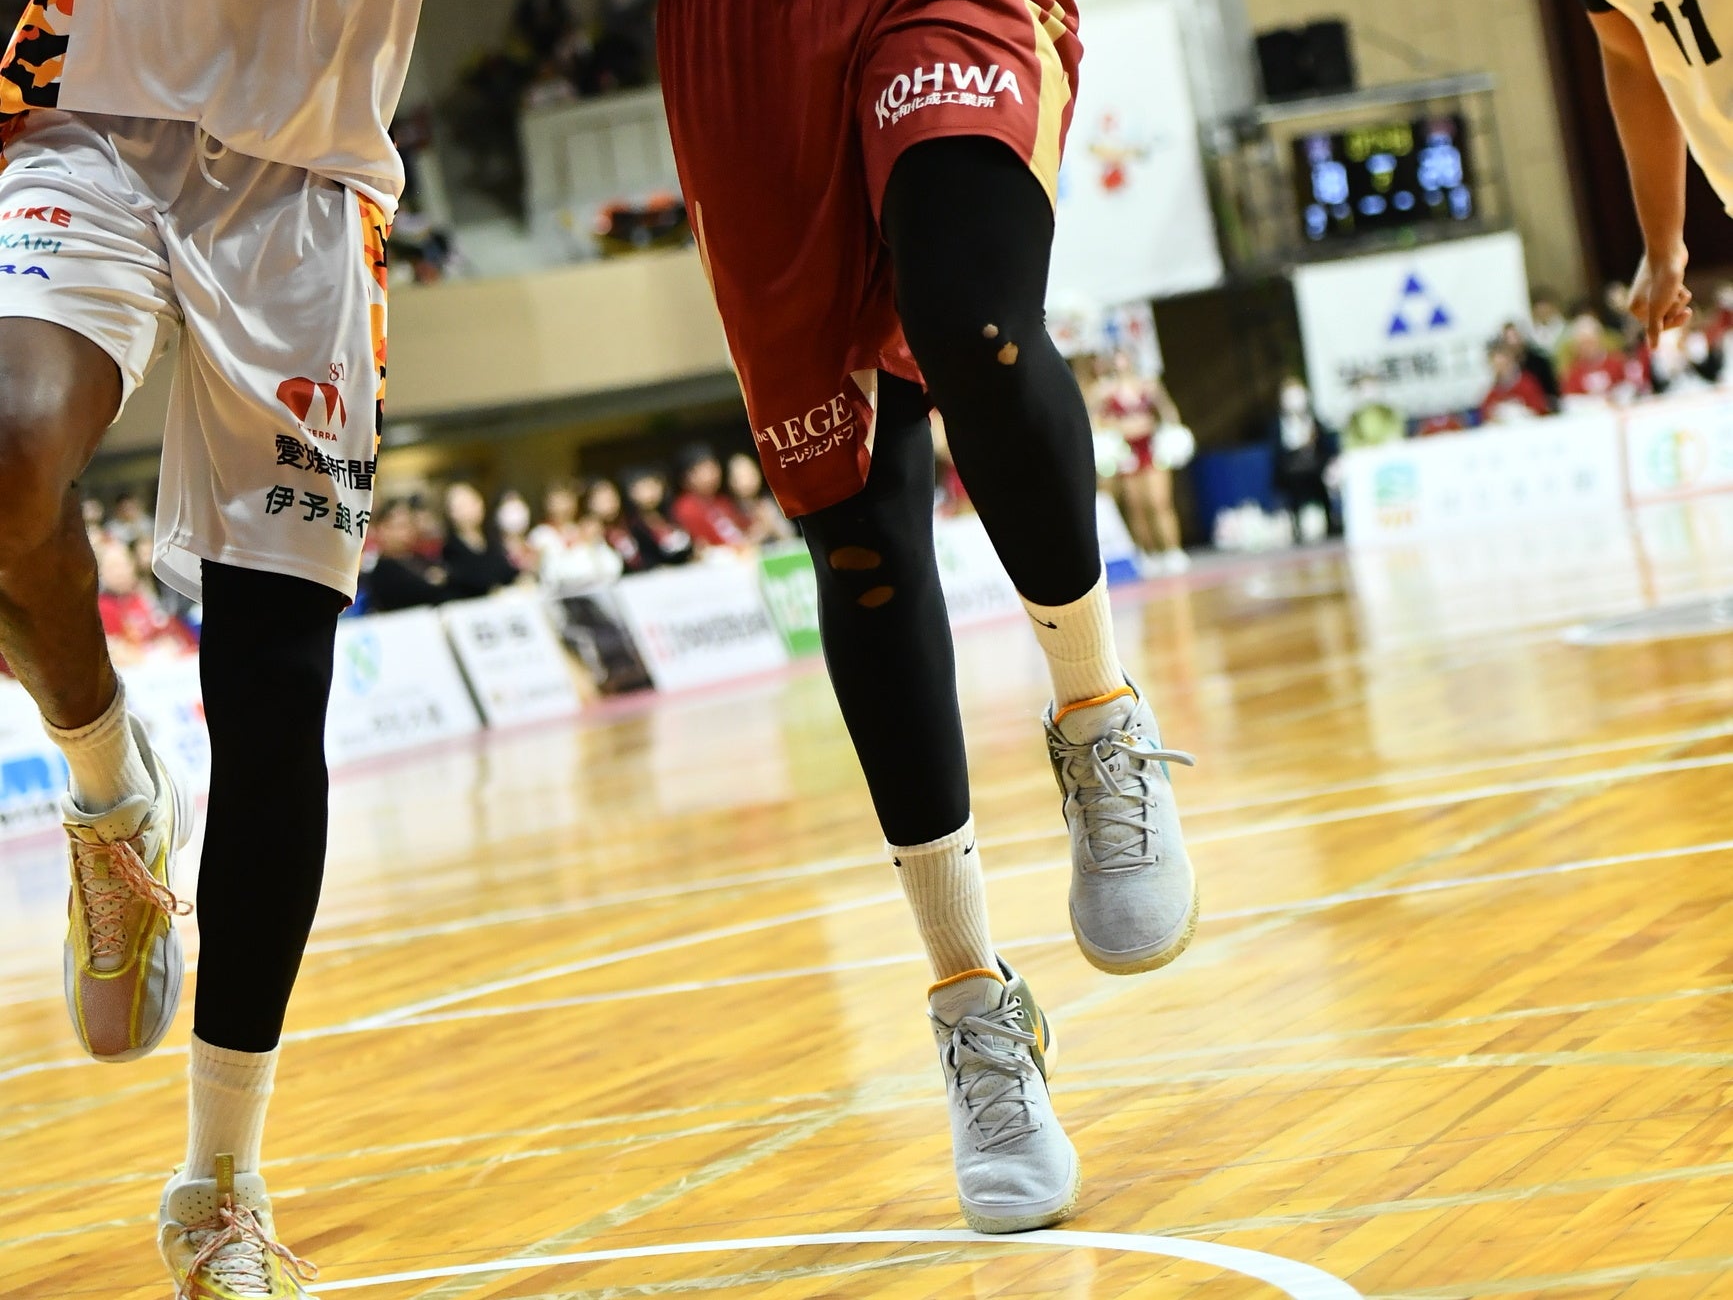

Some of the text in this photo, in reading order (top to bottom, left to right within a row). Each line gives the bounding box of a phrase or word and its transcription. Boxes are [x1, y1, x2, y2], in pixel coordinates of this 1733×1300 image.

[875, 63, 1023, 130] KOHWA
[275, 434, 376, 491] 愛媛新聞
